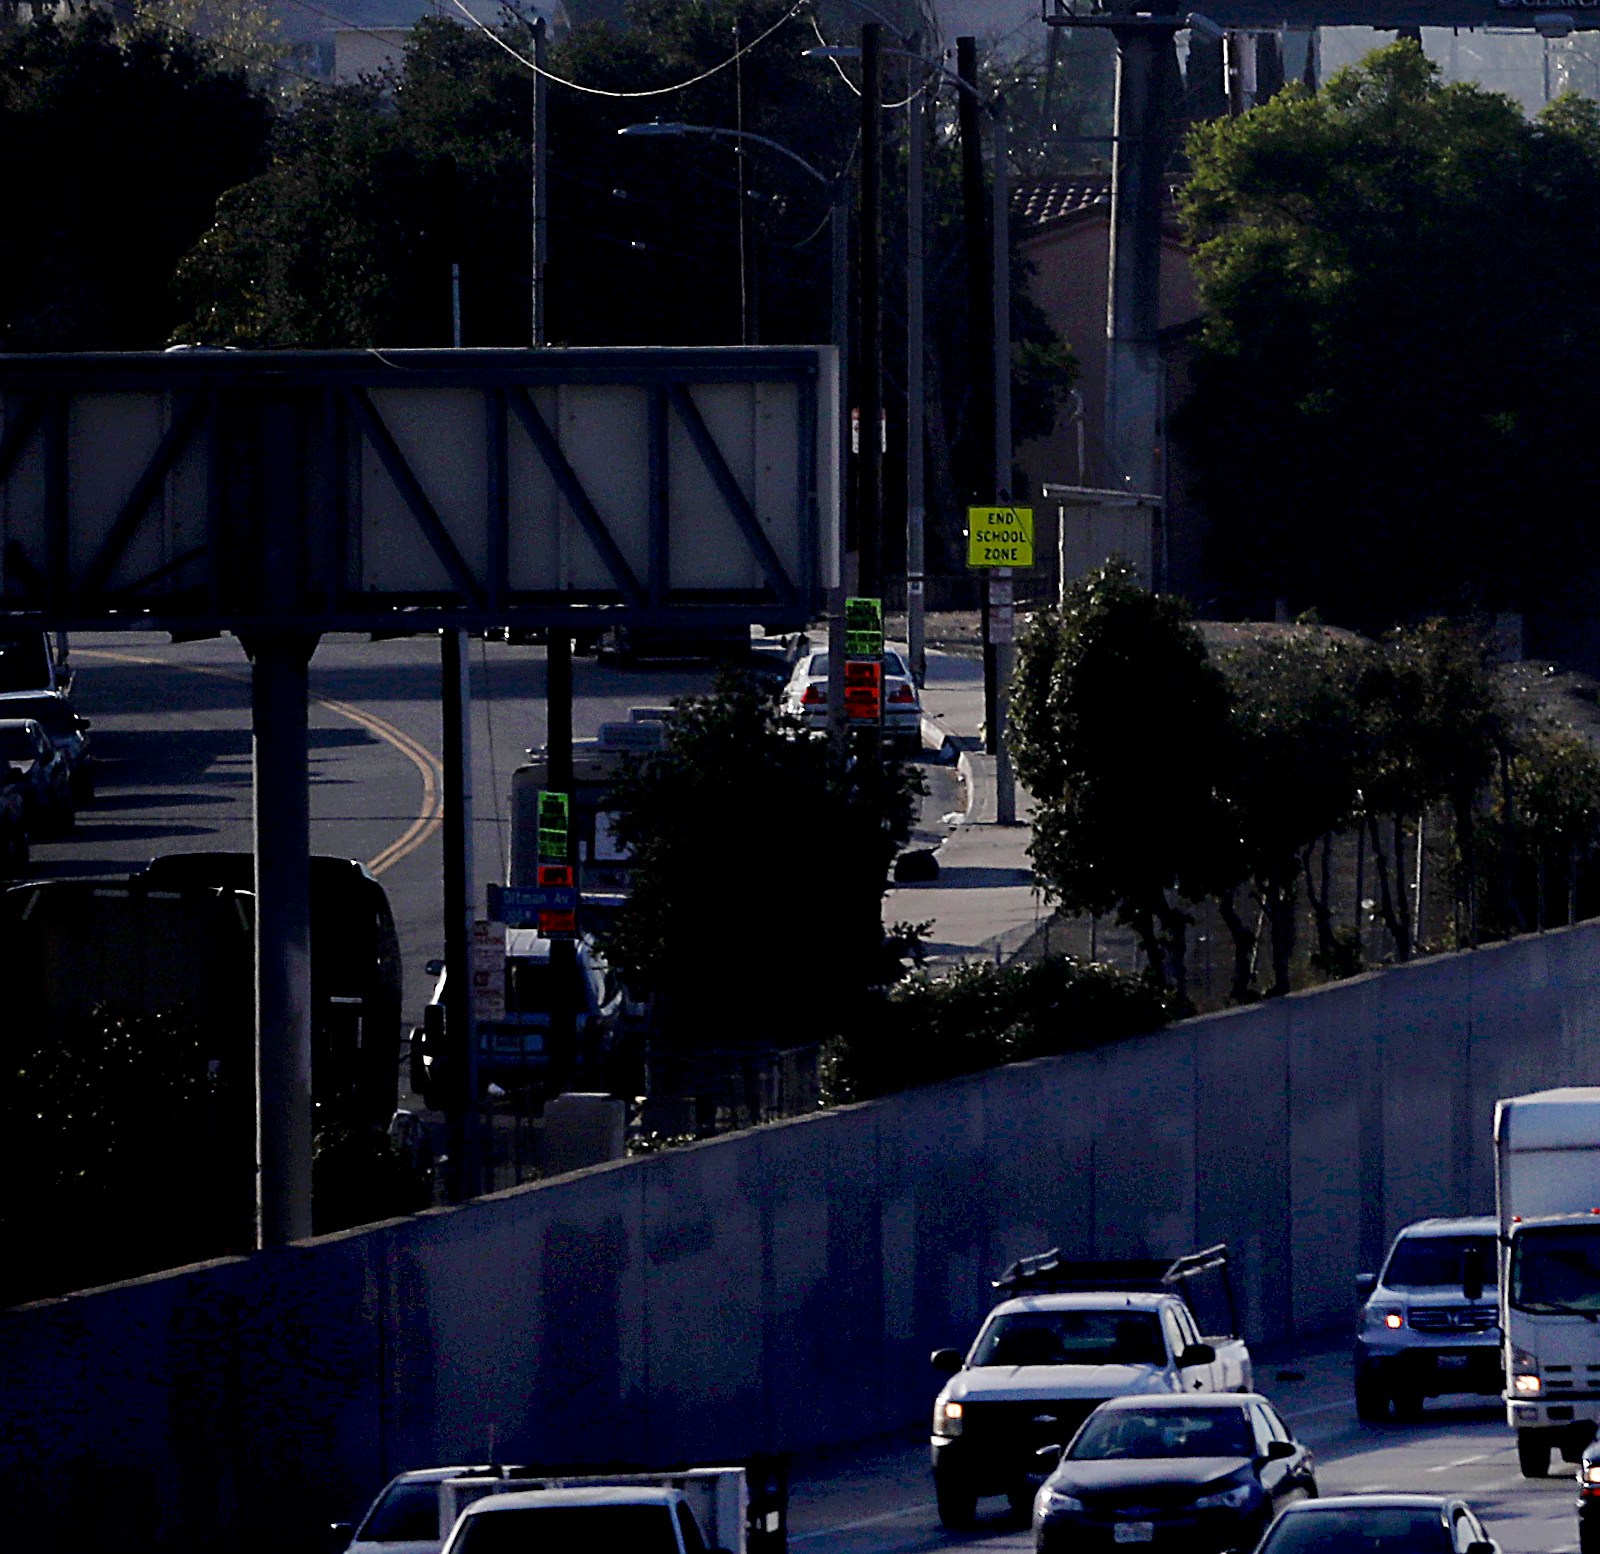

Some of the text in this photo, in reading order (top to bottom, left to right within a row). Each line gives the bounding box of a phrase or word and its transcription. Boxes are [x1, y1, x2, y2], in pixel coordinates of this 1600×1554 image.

[988, 512, 1014, 525] END
[976, 530, 1026, 543] SCHOOL
[984, 548, 1018, 561] ZONE
